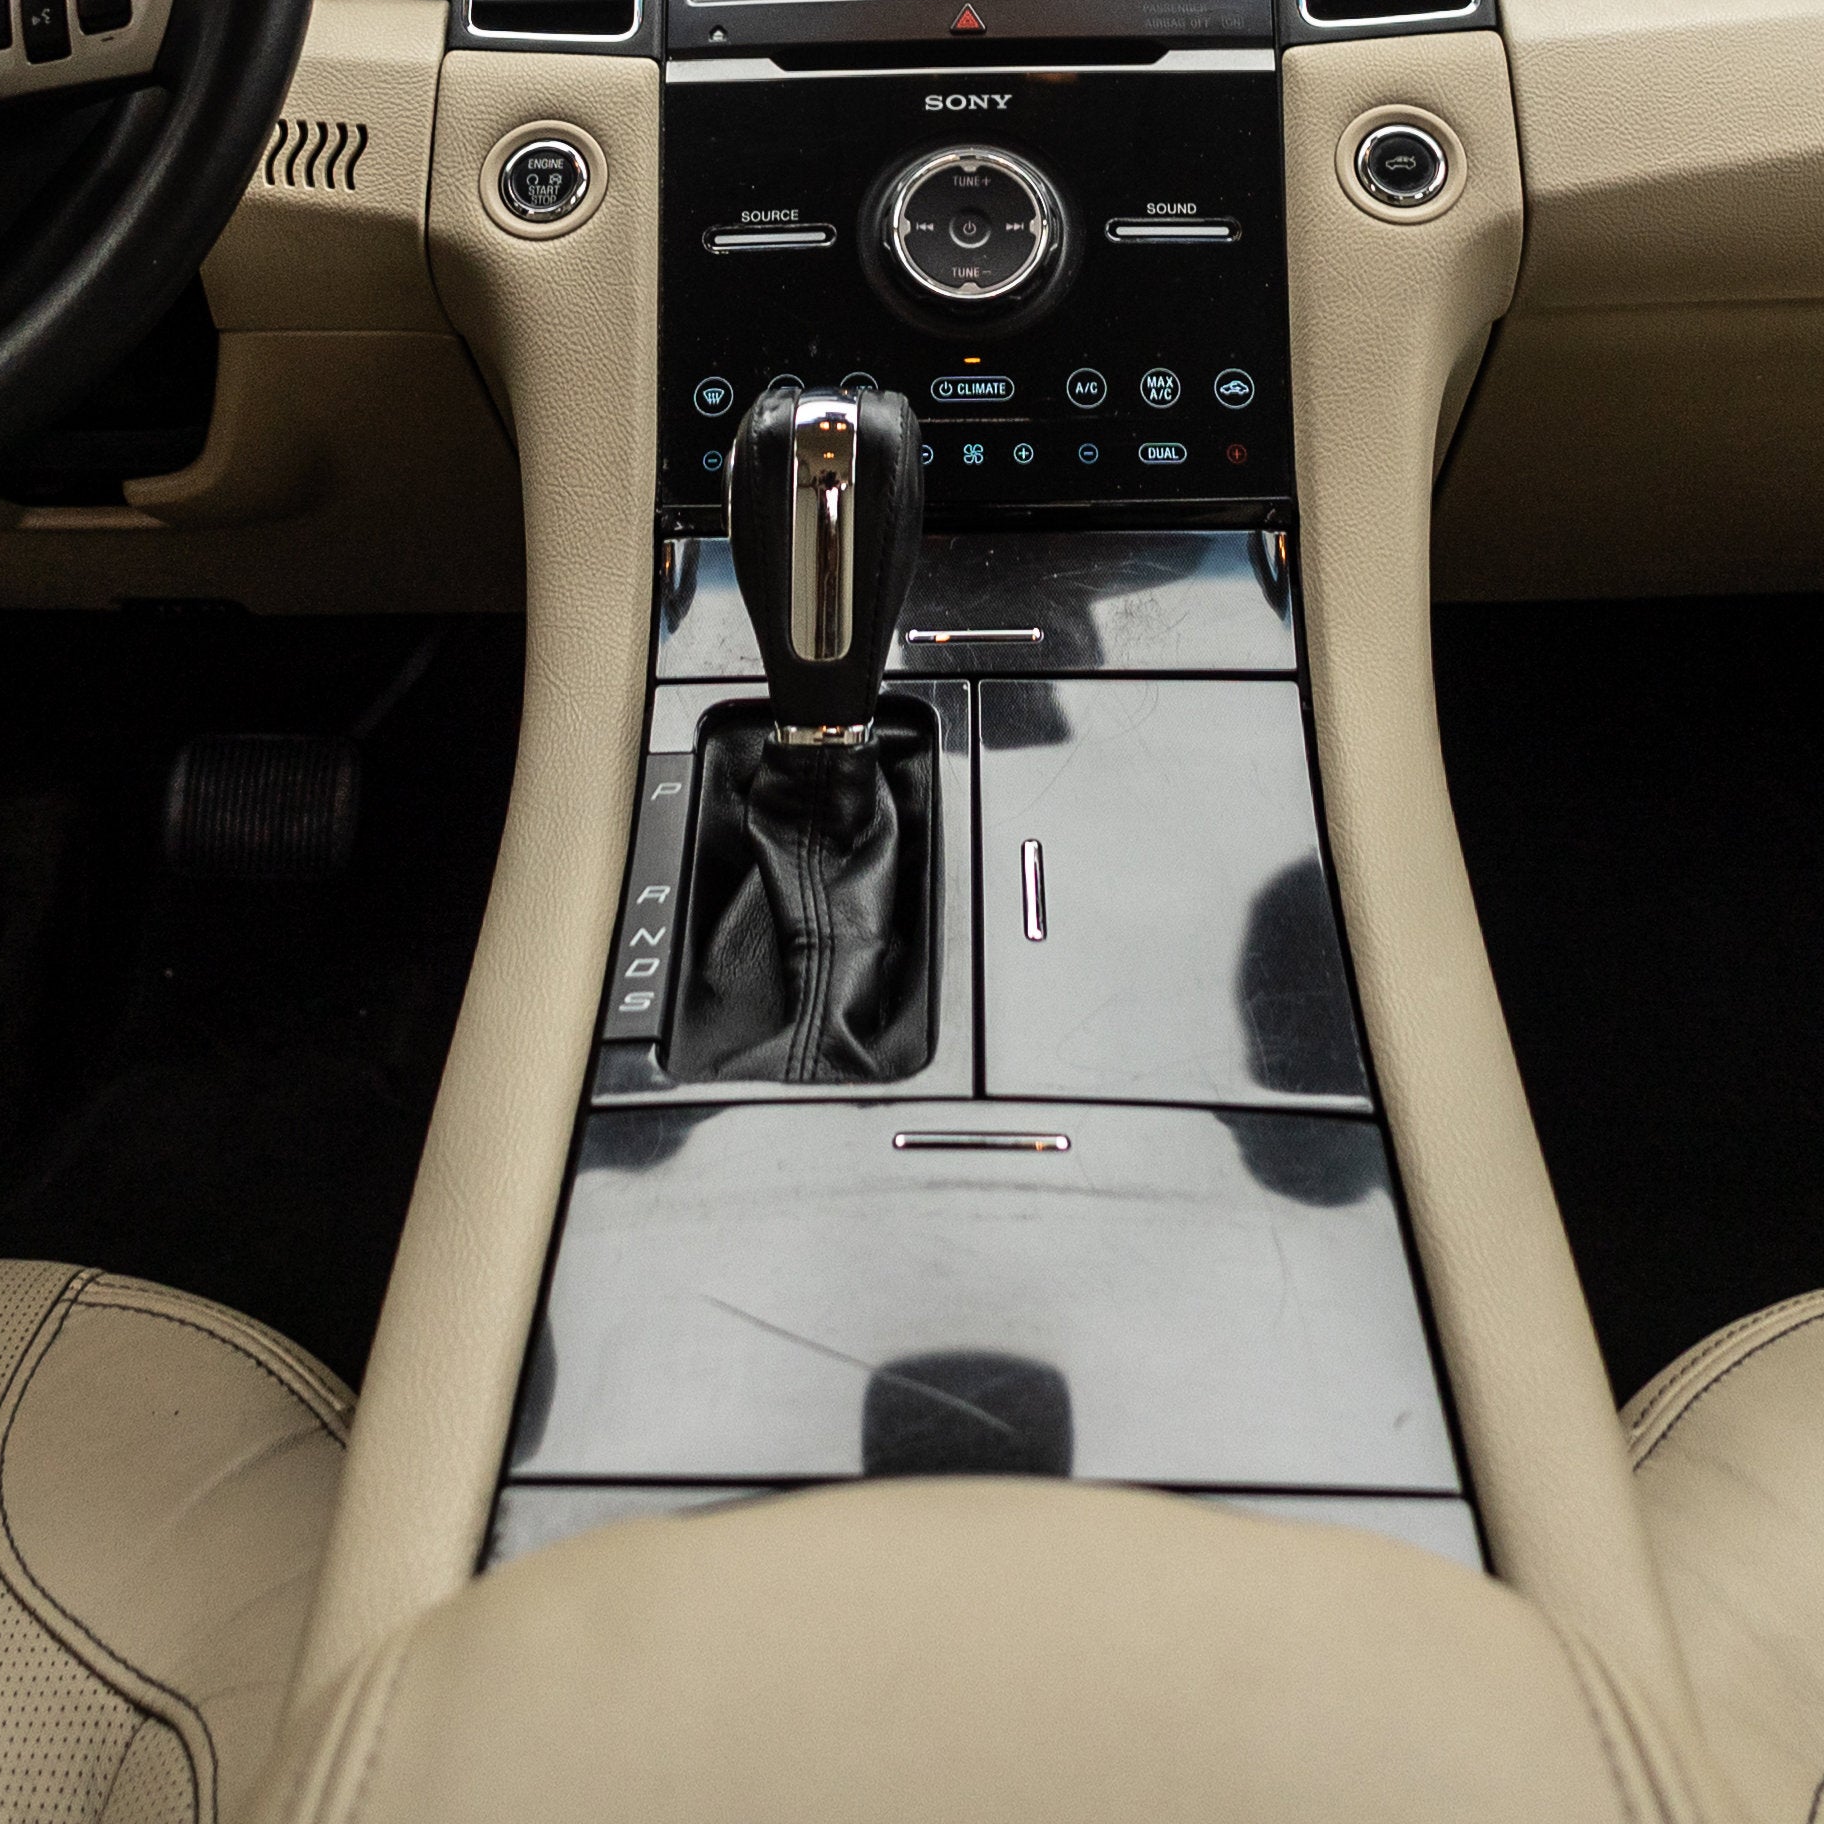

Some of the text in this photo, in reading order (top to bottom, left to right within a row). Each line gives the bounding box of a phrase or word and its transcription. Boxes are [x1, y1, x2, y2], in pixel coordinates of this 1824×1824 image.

[924, 93, 1013, 111] SONY
[528, 158, 563, 169] ENGINE
[528, 185, 560, 196] START
[531, 196, 557, 205] STOP
[741, 208, 800, 223] SOURCE
[1146, 202, 1198, 216] SOUND
[957, 382, 1007, 395] CLIMATE
[1075, 381, 1099, 395] A/C
[1147, 375, 1174, 388] MAX
[1149, 388, 1173, 401] A/C
[1147, 446, 1180, 460] DUAL
[650, 782, 683, 801] P
[636, 885, 671, 905] R
[629, 926, 667, 947] N
[624, 957, 661, 978] D
[618, 991, 656, 1013] S
